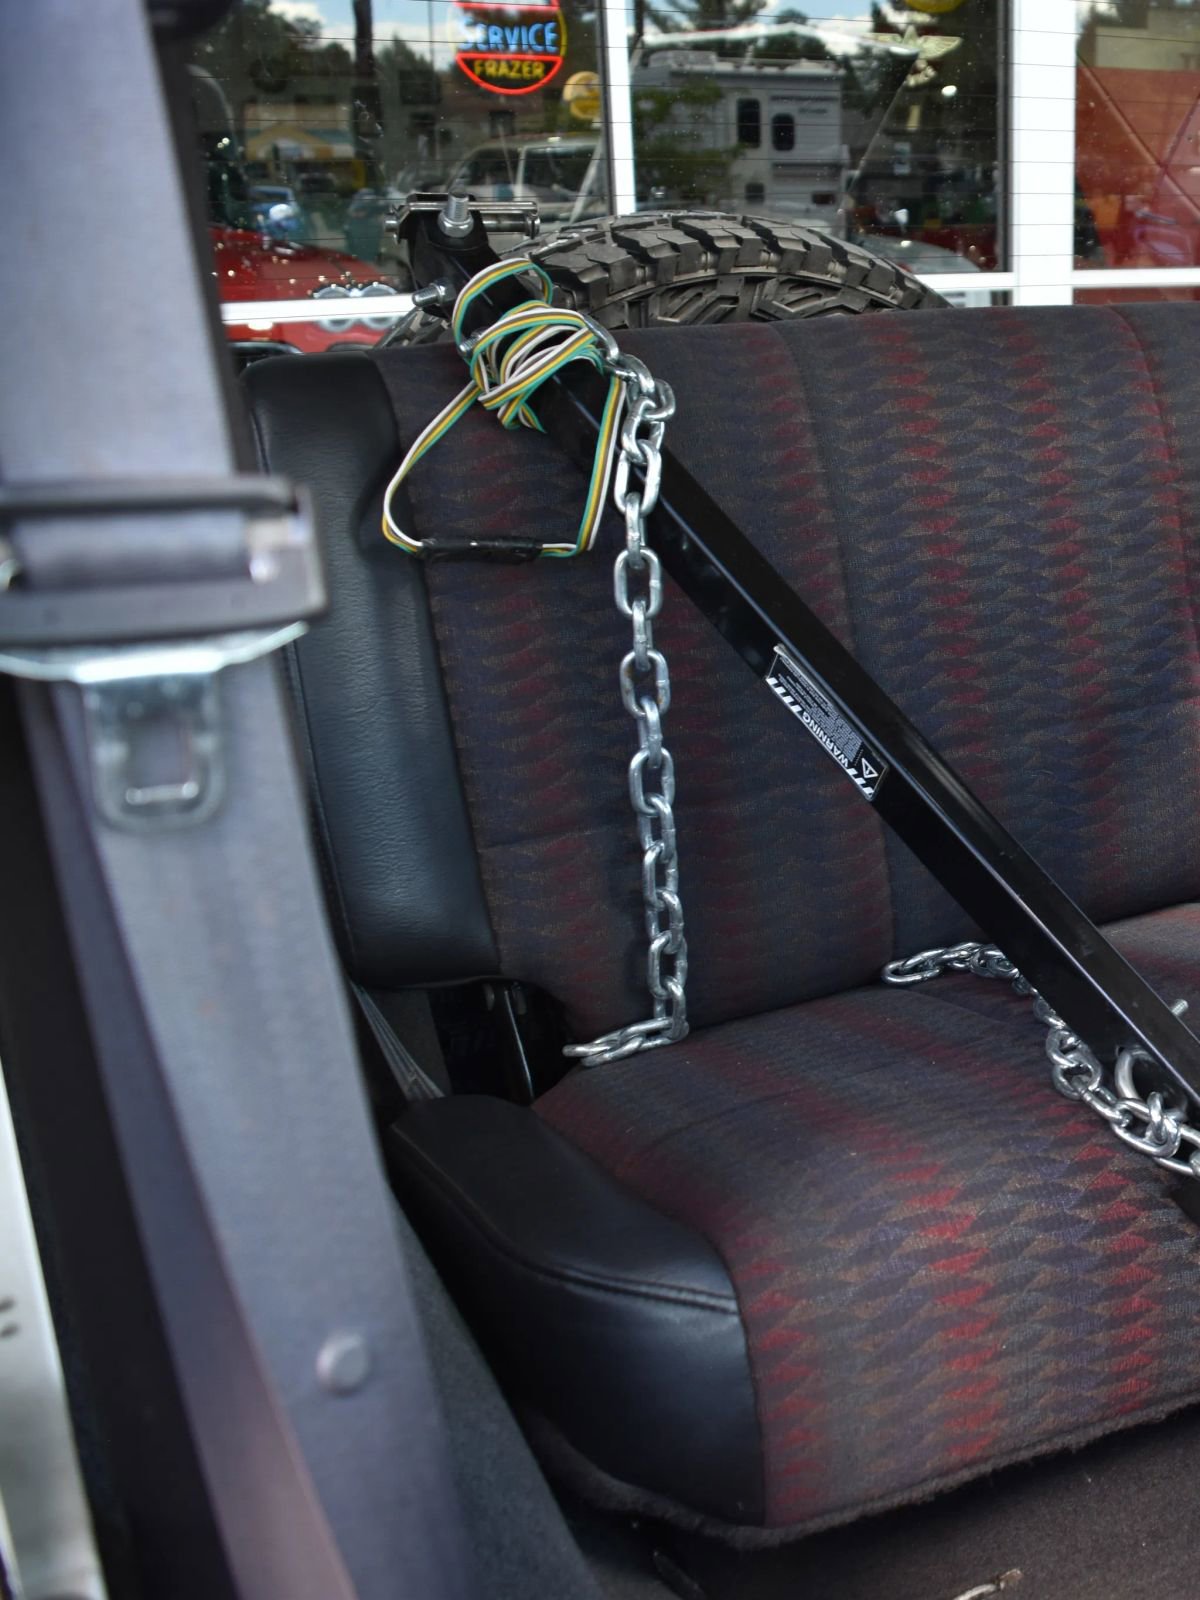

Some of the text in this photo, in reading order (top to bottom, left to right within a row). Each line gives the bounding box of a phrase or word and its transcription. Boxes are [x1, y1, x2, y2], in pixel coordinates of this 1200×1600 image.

[459, 18, 558, 52] SERVICE
[474, 59, 545, 79] FRAZER
[802, 711, 849, 768] WARNING
